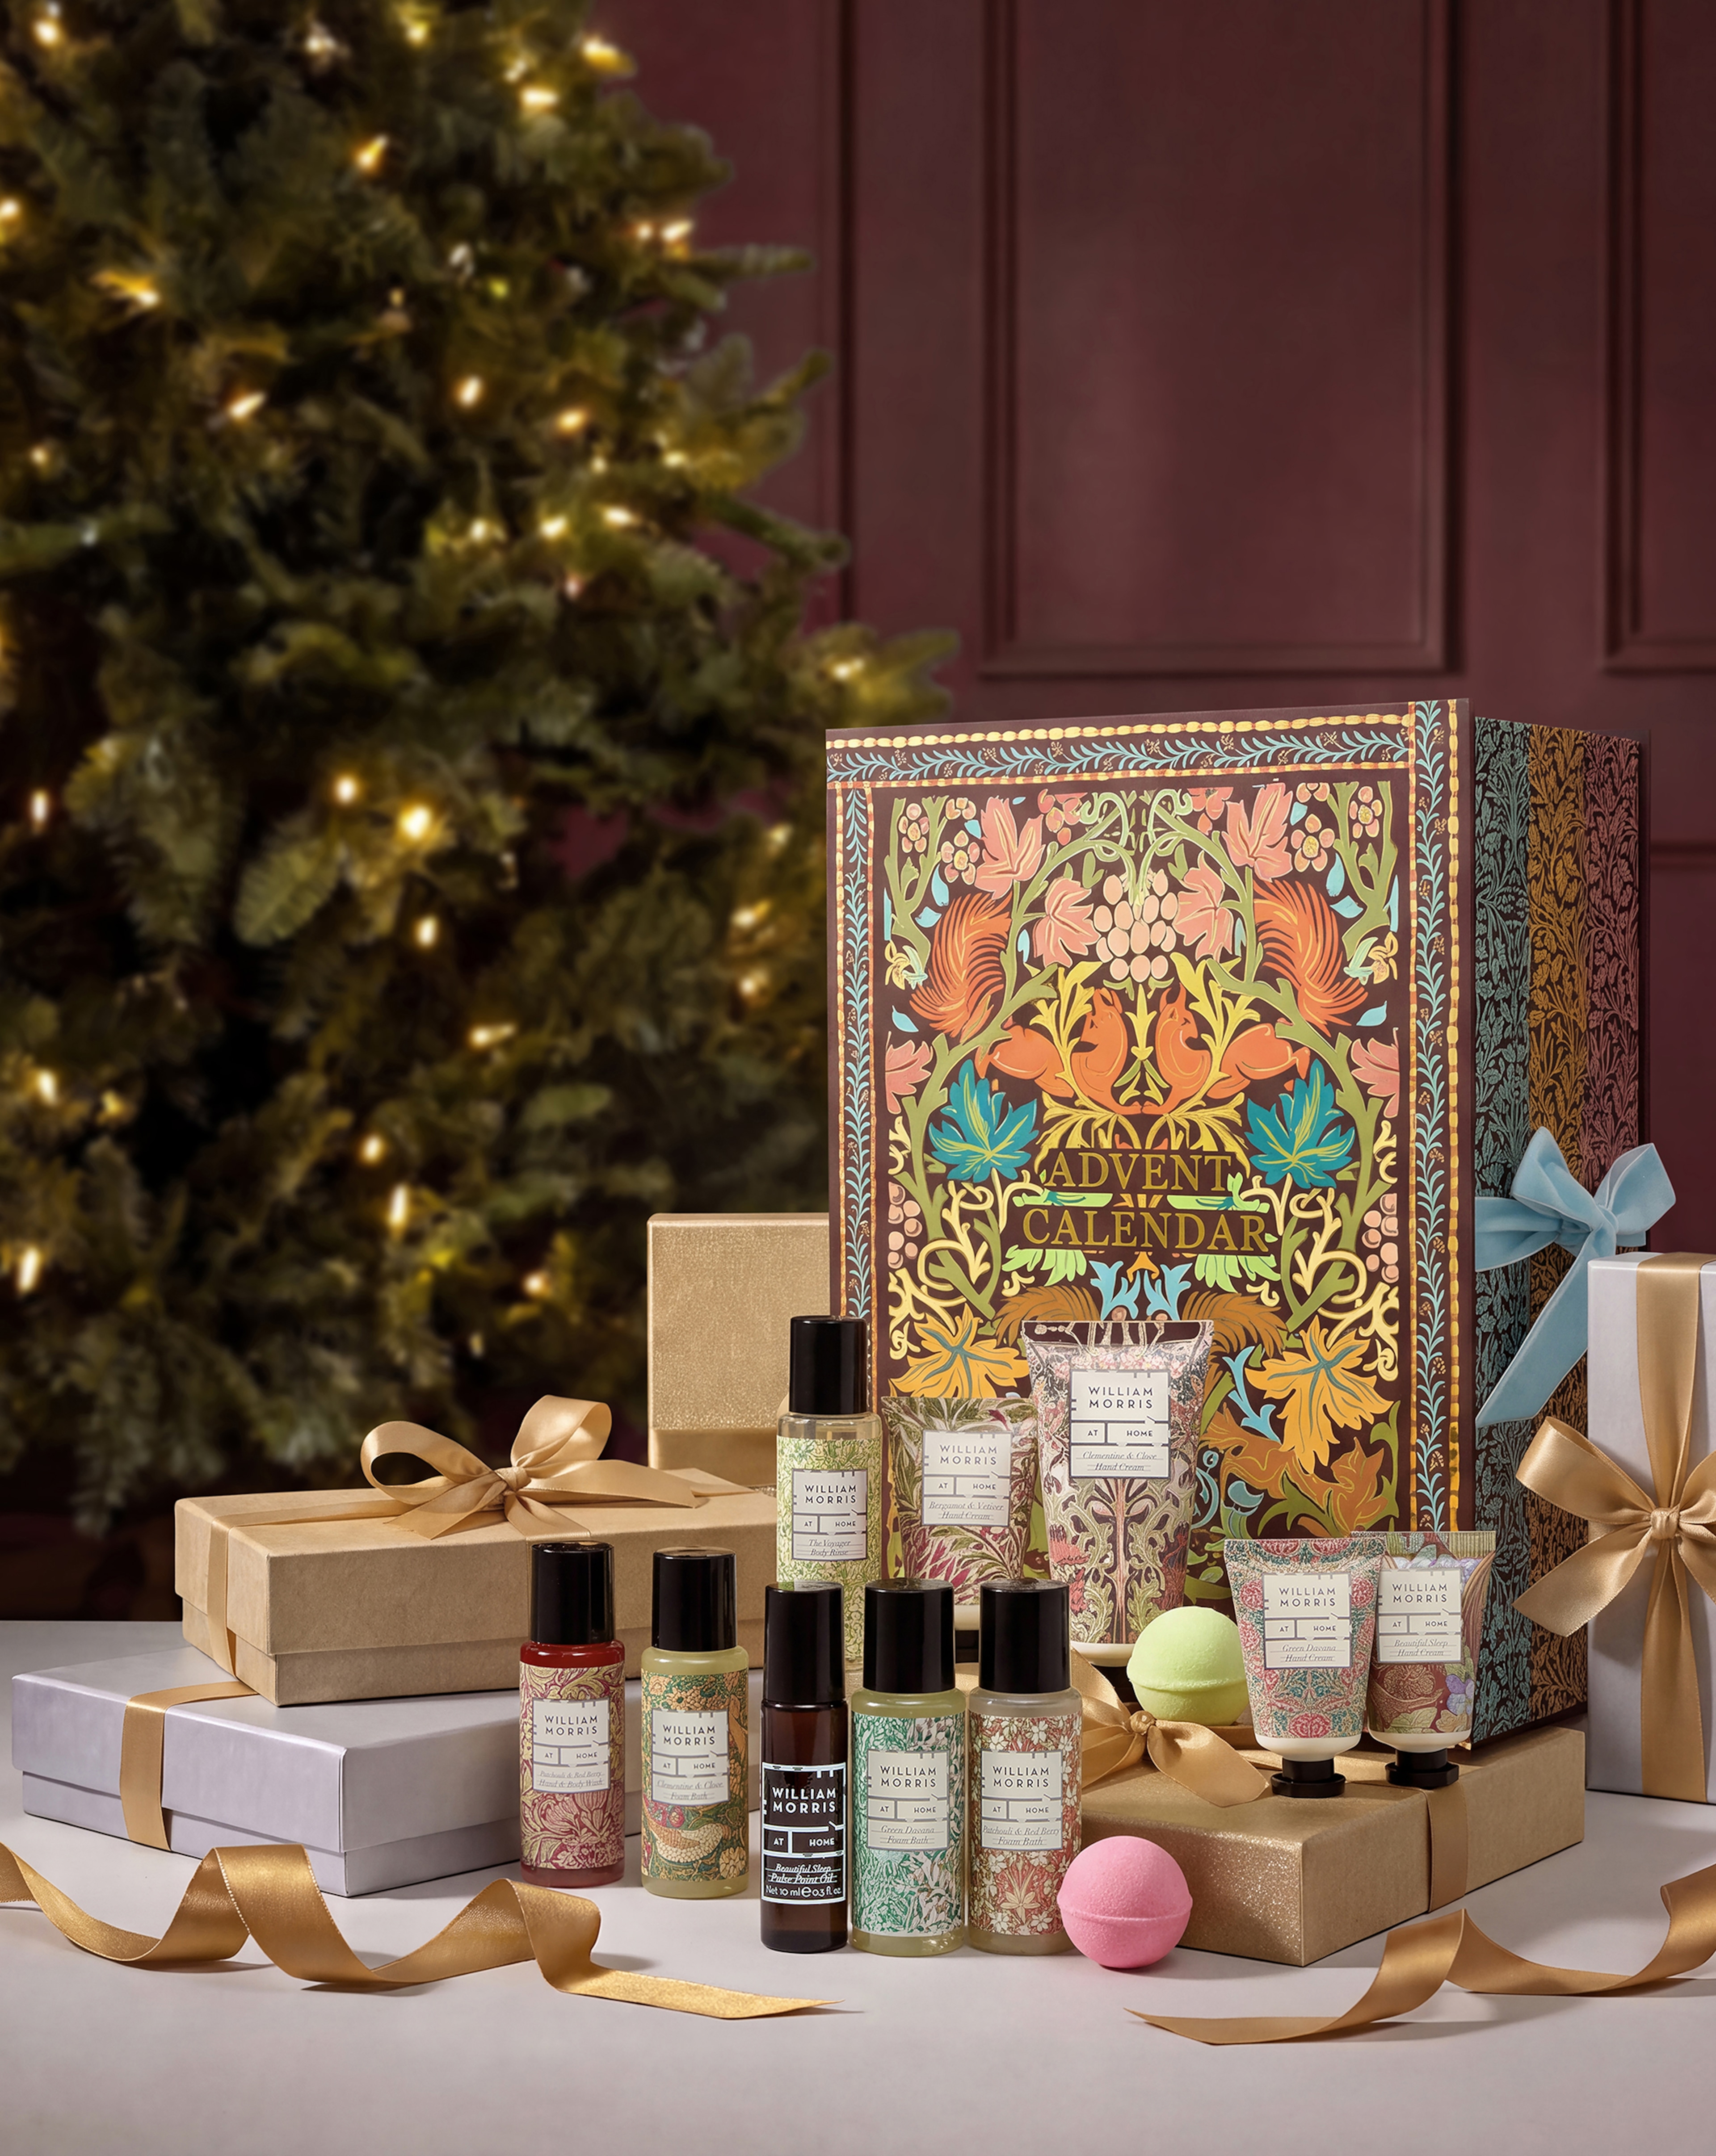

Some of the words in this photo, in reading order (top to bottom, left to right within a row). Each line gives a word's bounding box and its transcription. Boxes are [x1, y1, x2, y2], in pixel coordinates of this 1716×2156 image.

[1044, 1152, 1231, 1191] ADVENT
[1023, 1208, 1269, 1252] CALENDAR
[1089, 1386, 1152, 1396] WILLIAM
[1089, 1399, 1152, 1408] MORRIS
[940, 1445, 997, 1453] WILLIAM
[940, 1456, 997, 1465] MORRIS
[805, 1485, 856, 1493] WILLIAM
[806, 1495, 856, 1504] MORRIS
[929, 1502, 965, 1510] Bergamot
[977, 1502, 1003, 1510] Vetiver
[811, 1549, 828, 1557] Body
[1279, 1588, 1336, 1596] WILLIAM
[1392, 1583, 1447, 1592] WILLIAM
[1280, 1598, 1335, 1607] MORRIS
[1393, 1594, 1447, 1602] MORRIS
[1394, 1639, 1427, 1648] Beautiful
[1429, 1639, 1448, 1647] Sleep
[1285, 1654, 1307, 1662] Hand
[545, 1715, 598, 1724] WILLIAM
[546, 1726, 597, 1736] MORRIS
[663, 1725, 715, 1734] WILLIAM
[664, 1737, 715, 1745] MORRIS
[880, 1766, 936, 1776] WILLIAM
[993, 1766, 1049, 1776] WILLIAM
[568, 1780, 584, 1789] Body
[657, 1779, 693, 1790] Clementine
[881, 1778, 936, 1787] MORRIS
[994, 1778, 1048, 1787] MORRIS
[690, 1792, 707, 1800] Bath
[772, 1787, 836, 1800] WILLIAM
[773, 1801, 836, 1813] MORRIS
[881, 1825, 903, 1833] Green
[905, 1826, 934, 1834] Davana
[983, 1825, 1013, 1835] Patchouli
[1041, 1828, 1059, 1836] Berry
[809, 1838, 835, 1847] HOME
[997, 1837, 1021, 1845] Foam
[1023, 1837, 1043, 1846] Bath
[775, 1863, 811, 1875] Beautiful
[812, 1864, 832, 1873] Sleep
[770, 1873, 792, 1883] Pulse
[794, 1874, 819, 1884] Point
[820, 1873, 833, 1883] Oil
[766, 1885, 778, 1895] Net
[779, 1888, 788, 1896] 10
